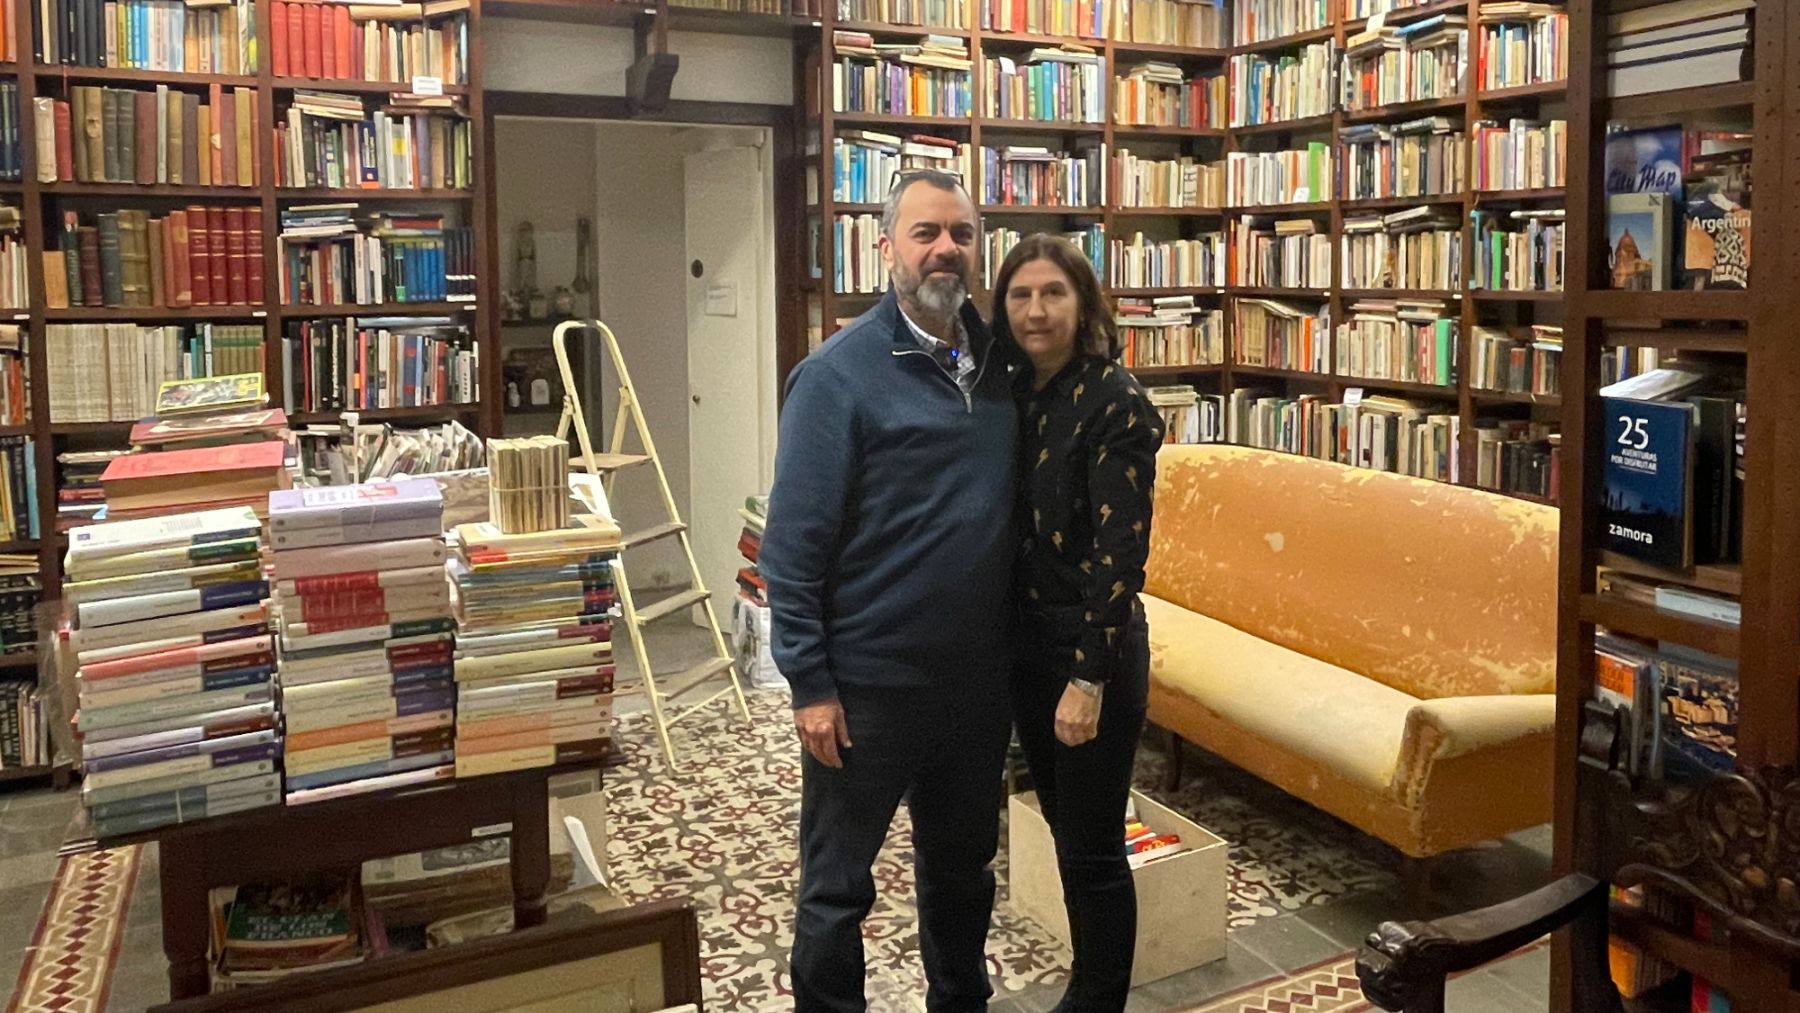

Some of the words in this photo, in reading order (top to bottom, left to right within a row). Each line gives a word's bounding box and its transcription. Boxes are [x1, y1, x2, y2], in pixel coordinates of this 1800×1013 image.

[1638, 164, 1677, 192] Map
[1691, 216, 1751, 233] Argentin
[1617, 415, 1649, 450] 25
[1611, 454, 1623, 465] POR
[1623, 457, 1657, 471] DISFRUTAR
[1621, 448, 1657, 462] AVENTURAS
[1609, 523, 1653, 544] zamora
